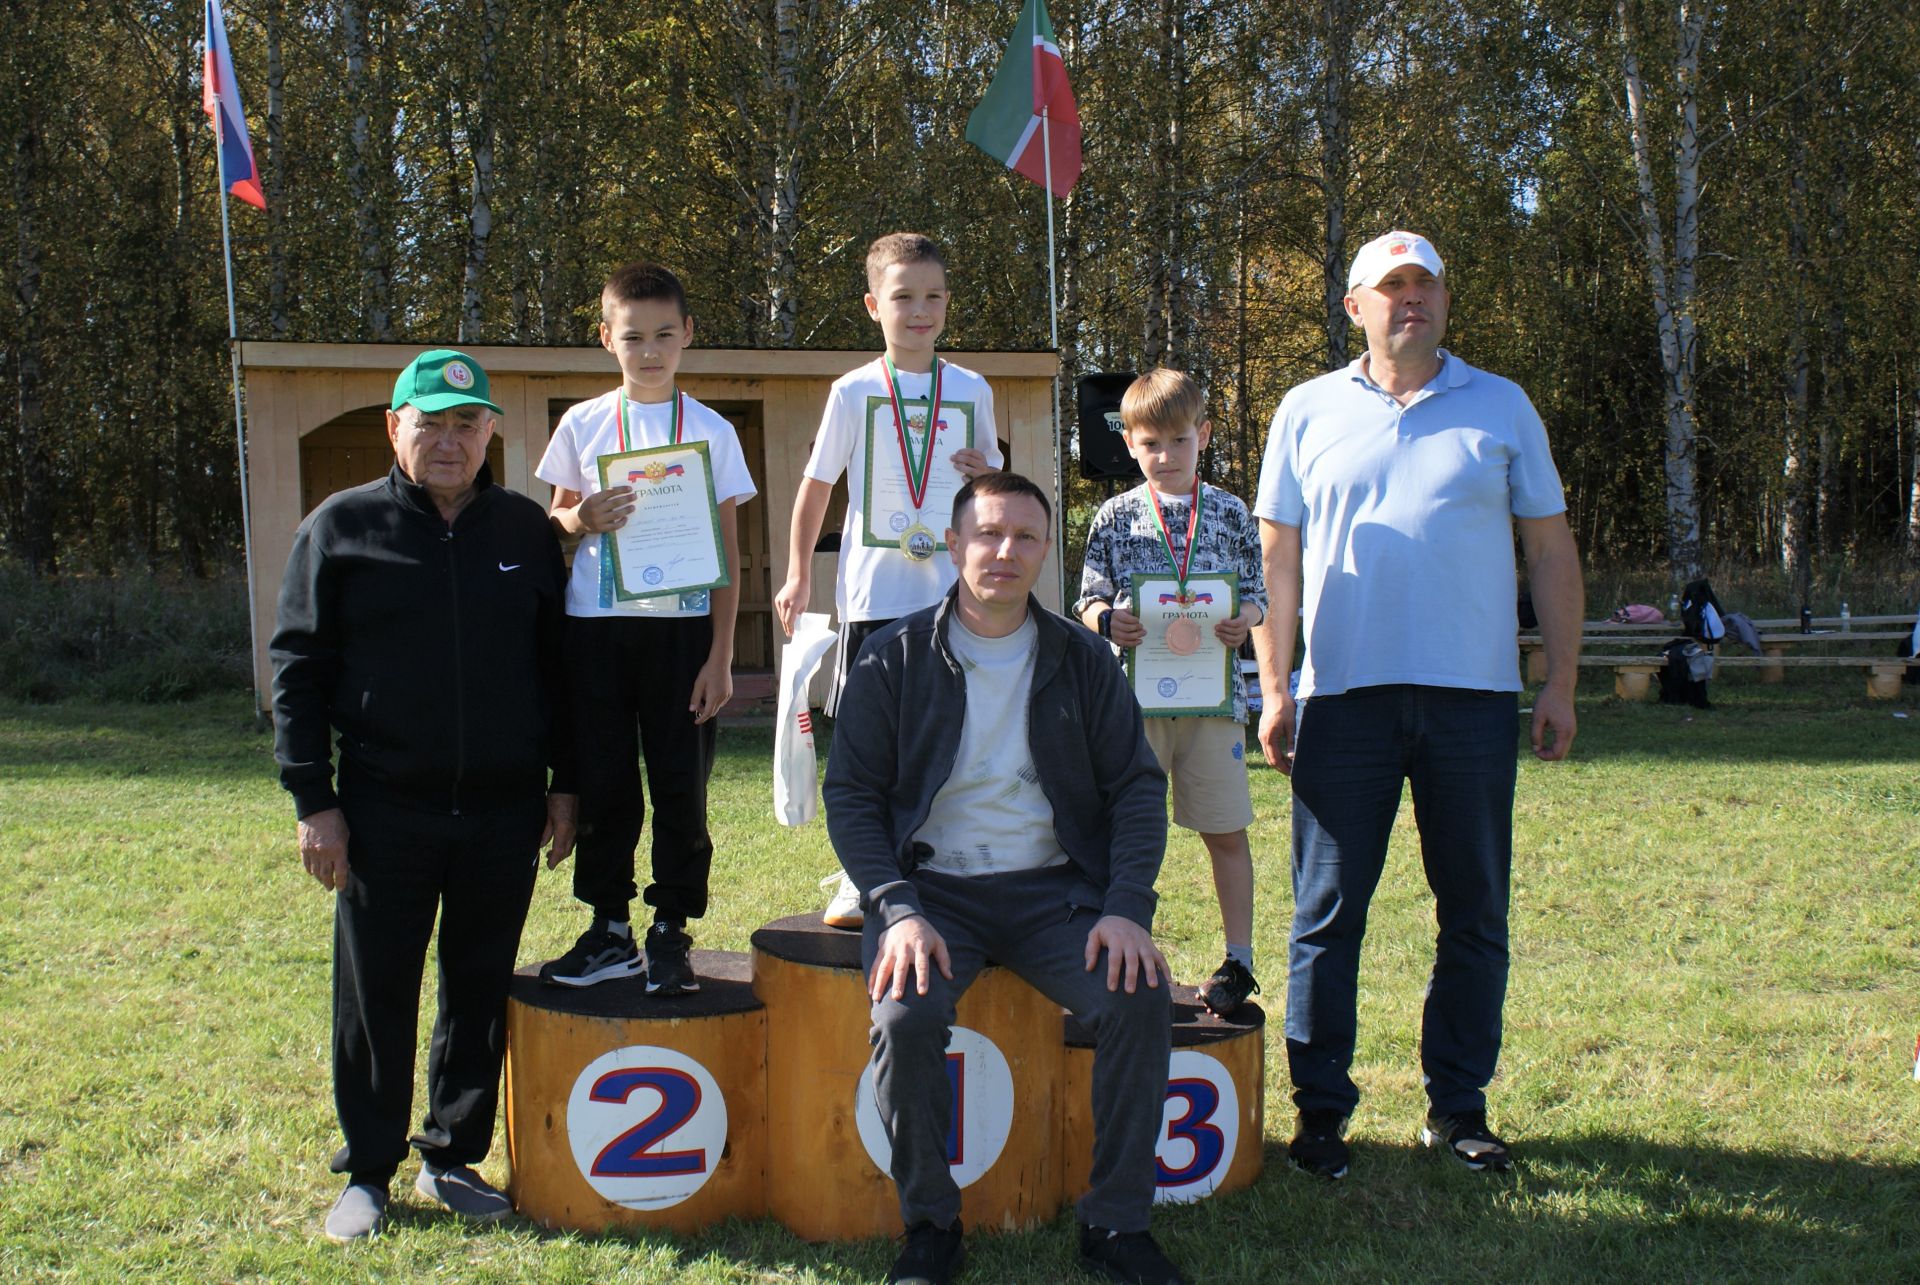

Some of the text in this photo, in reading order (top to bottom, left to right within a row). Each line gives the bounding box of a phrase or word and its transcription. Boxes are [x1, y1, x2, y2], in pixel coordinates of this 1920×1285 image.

[634, 484, 683, 497] ГРАМОТА
[589, 1066, 707, 1178] 2
[1154, 1077, 1225, 1188] 3
